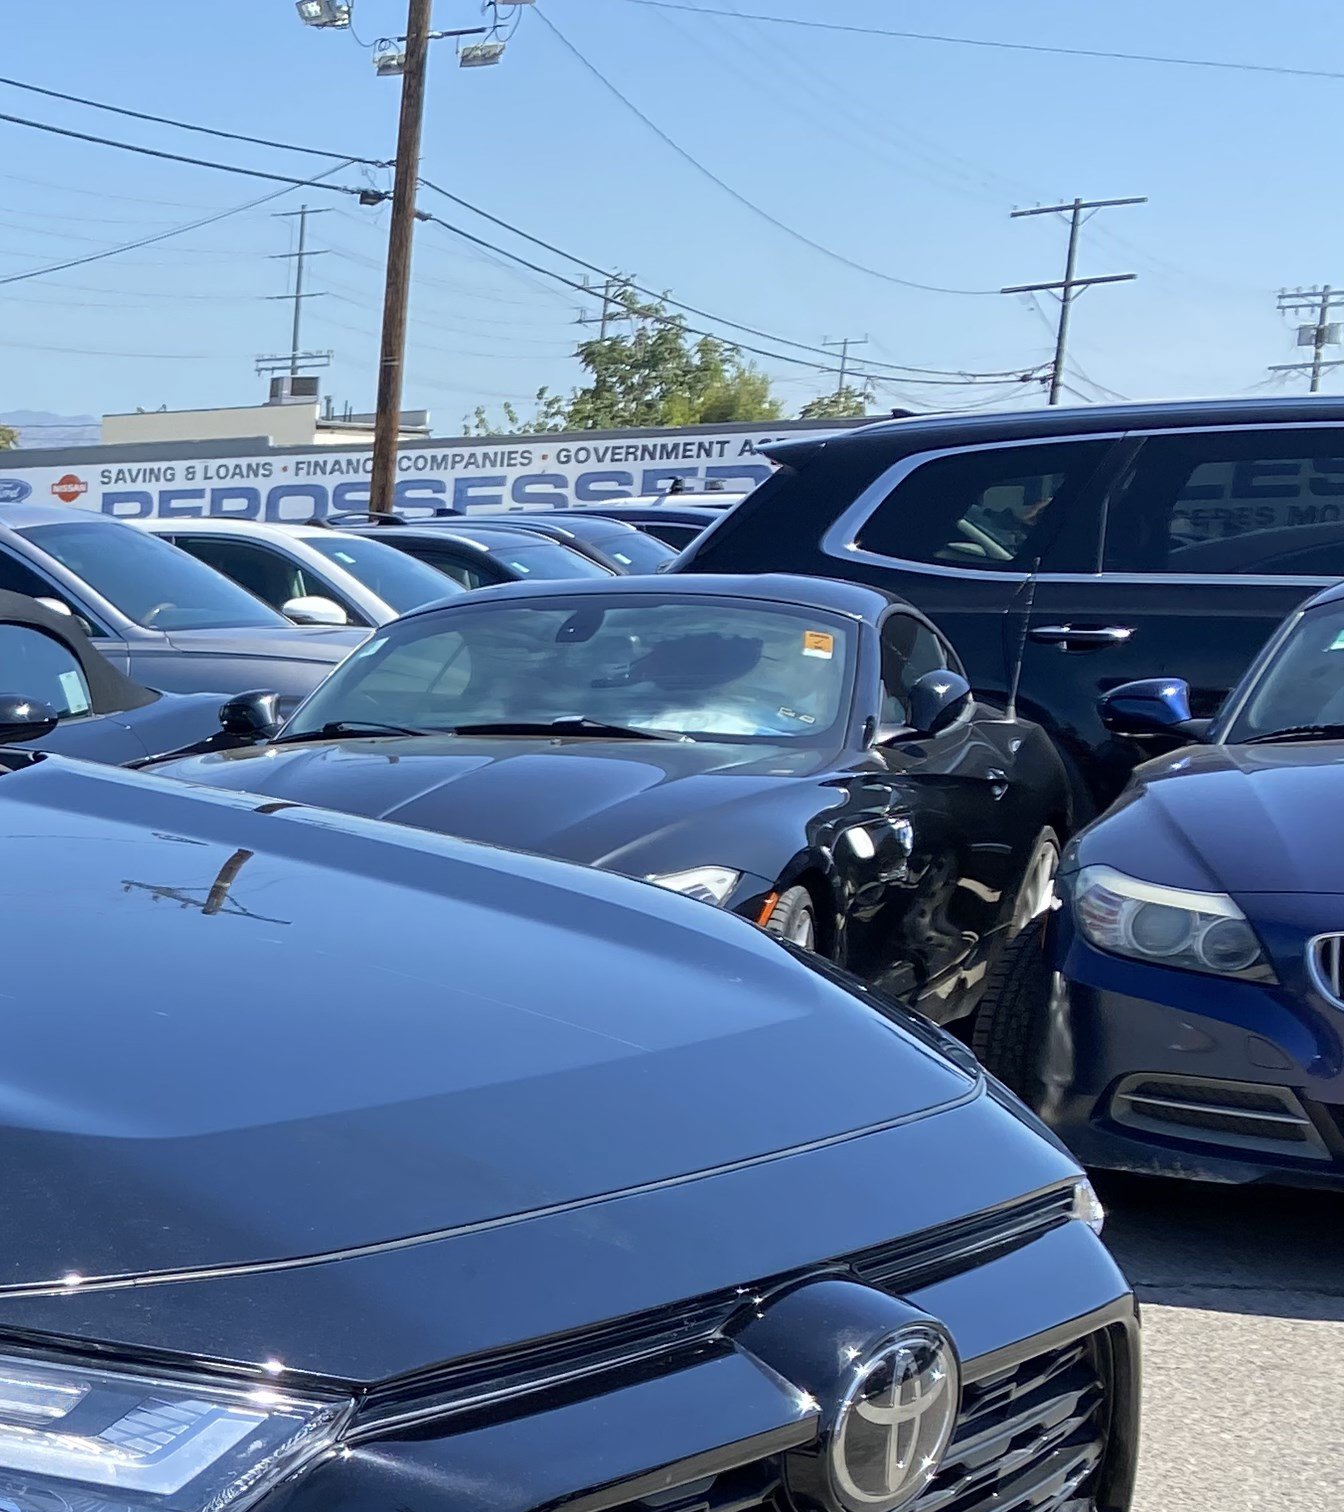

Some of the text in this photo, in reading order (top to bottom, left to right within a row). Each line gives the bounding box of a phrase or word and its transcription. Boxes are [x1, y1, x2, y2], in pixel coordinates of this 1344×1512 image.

[100, 466, 176, 485] SAVING
[185, 465, 197, 481] &
[203, 461, 274, 481] LOANS
[294, 457, 373, 477] FINANC
[397, 450, 533, 472] COMPANIES
[556, 440, 730, 465] GOVERNMENT
[52, 482, 87, 494] NISSAN
